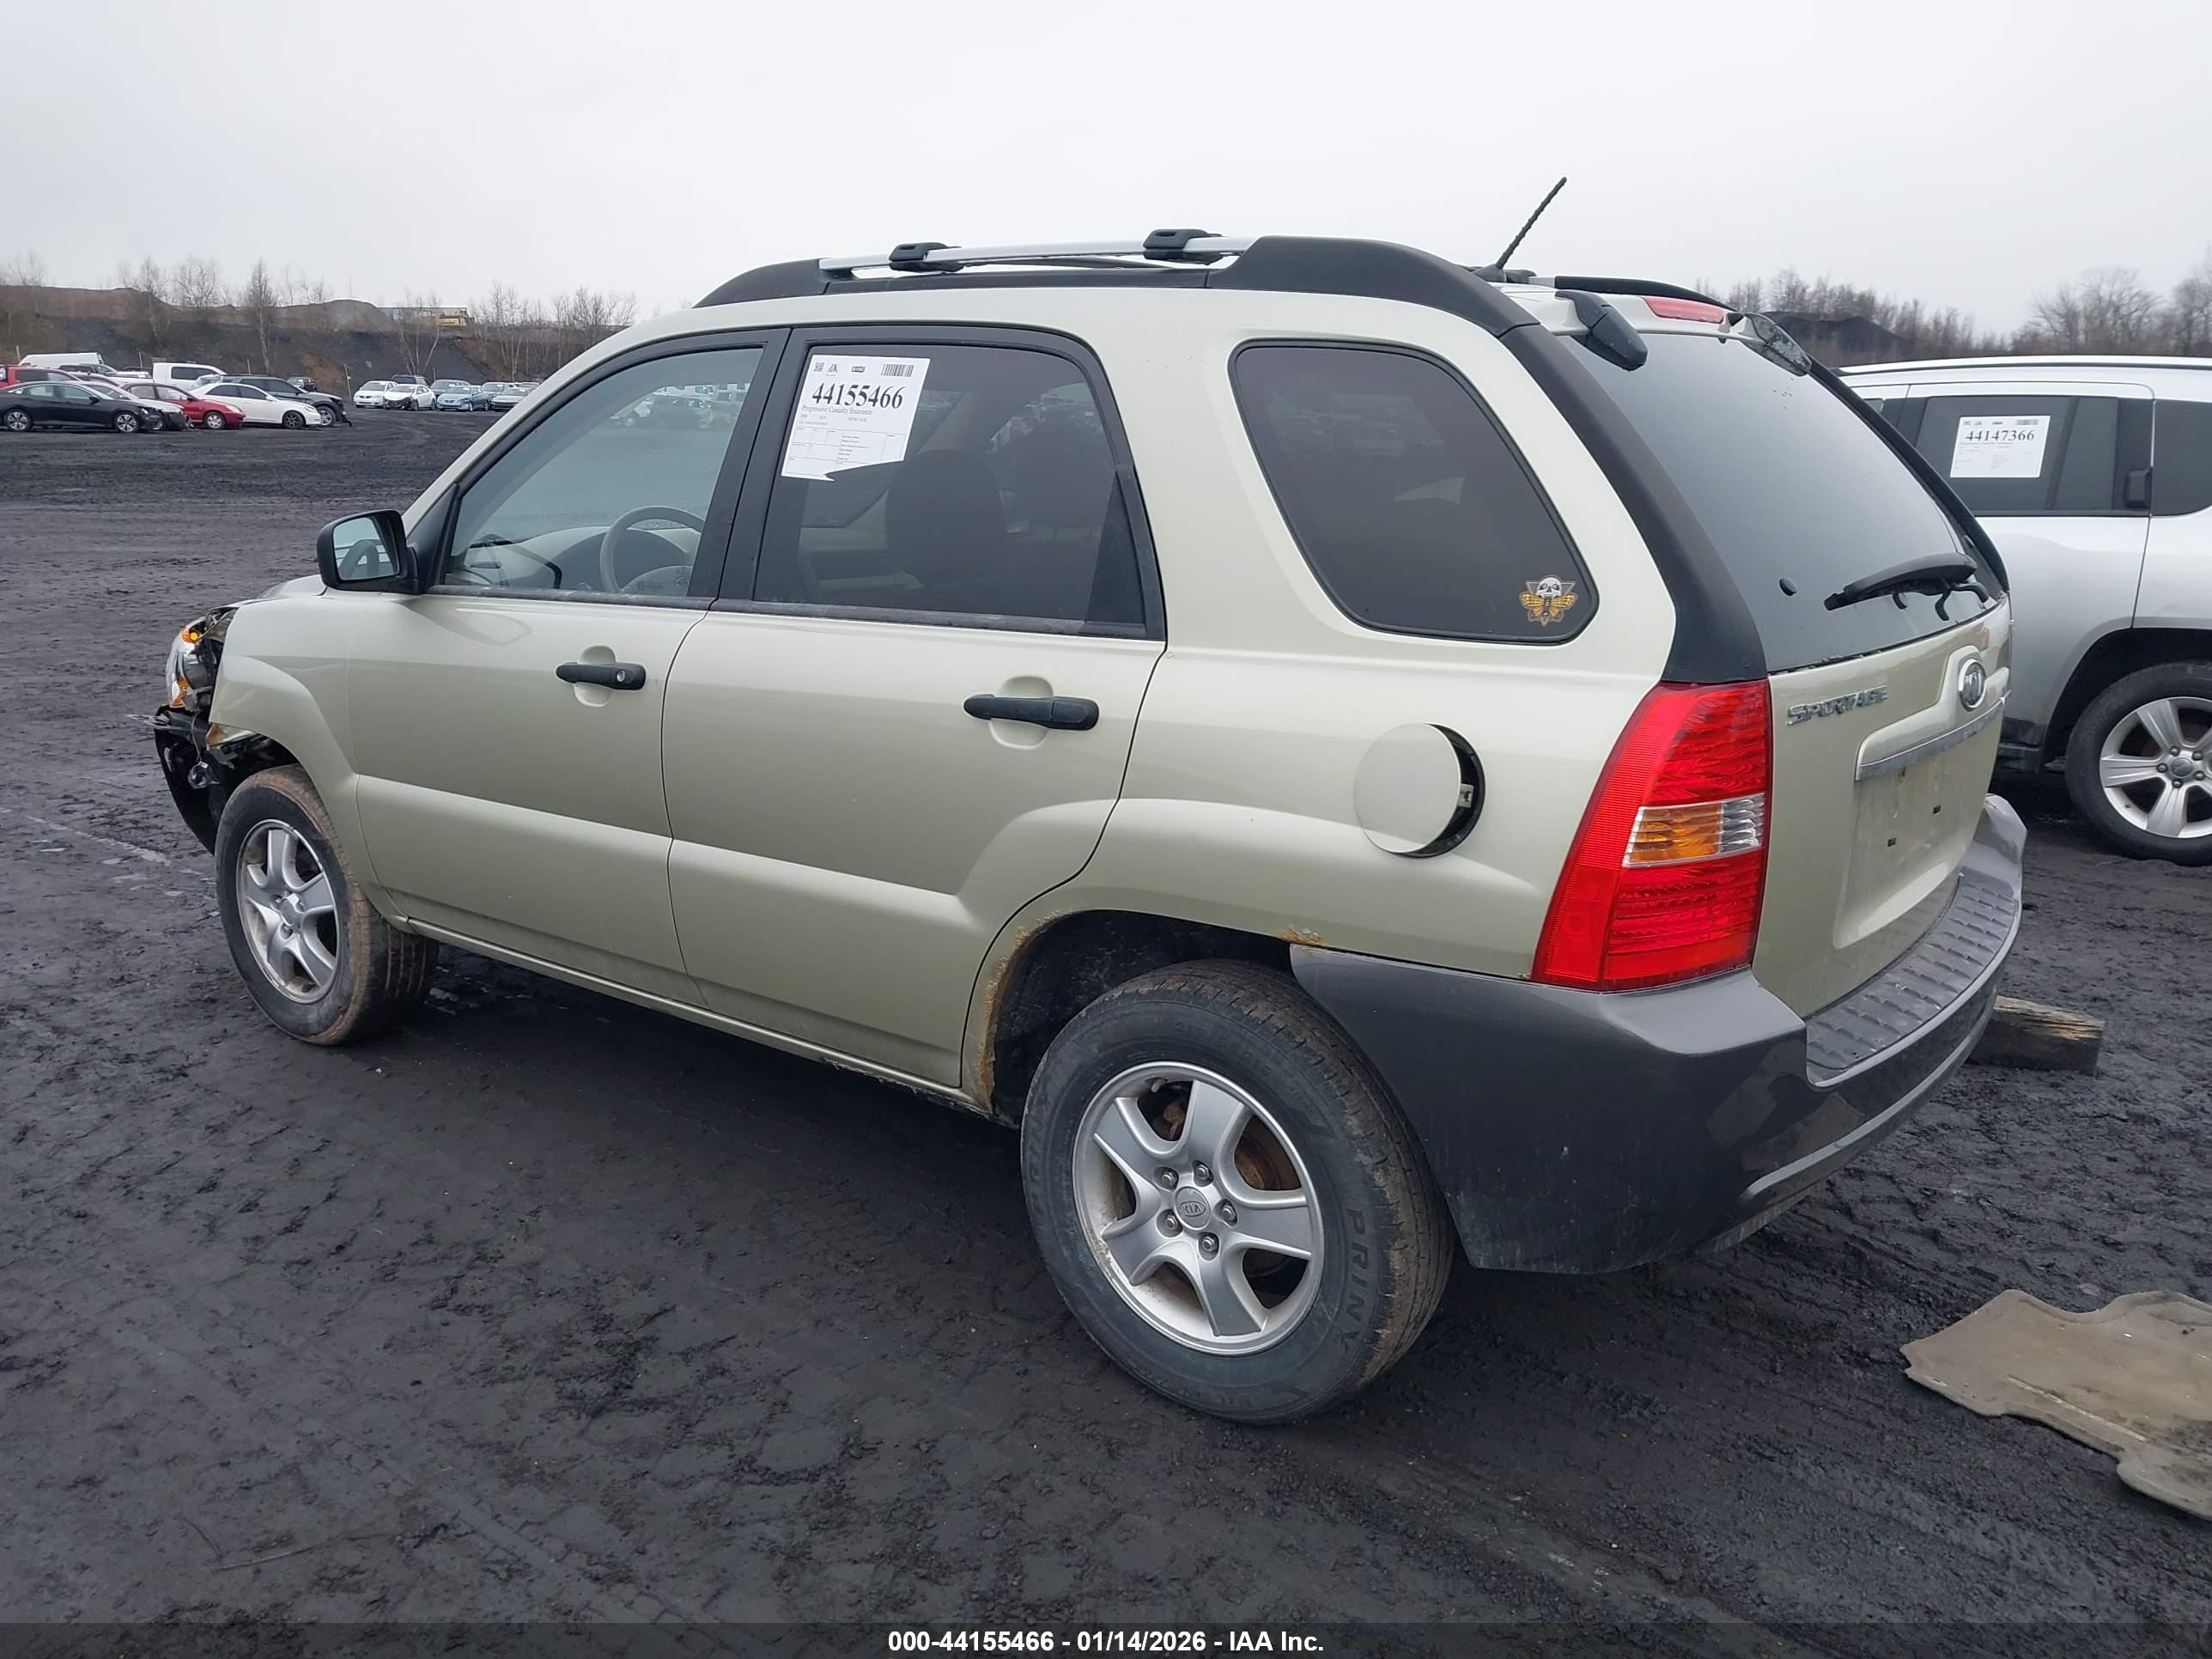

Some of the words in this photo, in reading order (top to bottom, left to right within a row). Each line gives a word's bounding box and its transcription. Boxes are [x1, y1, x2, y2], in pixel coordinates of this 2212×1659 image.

[812, 383, 906, 409] 44155466
[1966, 429, 2035, 441] 44147366
[1787, 685, 1888, 726] SPORTAGE
